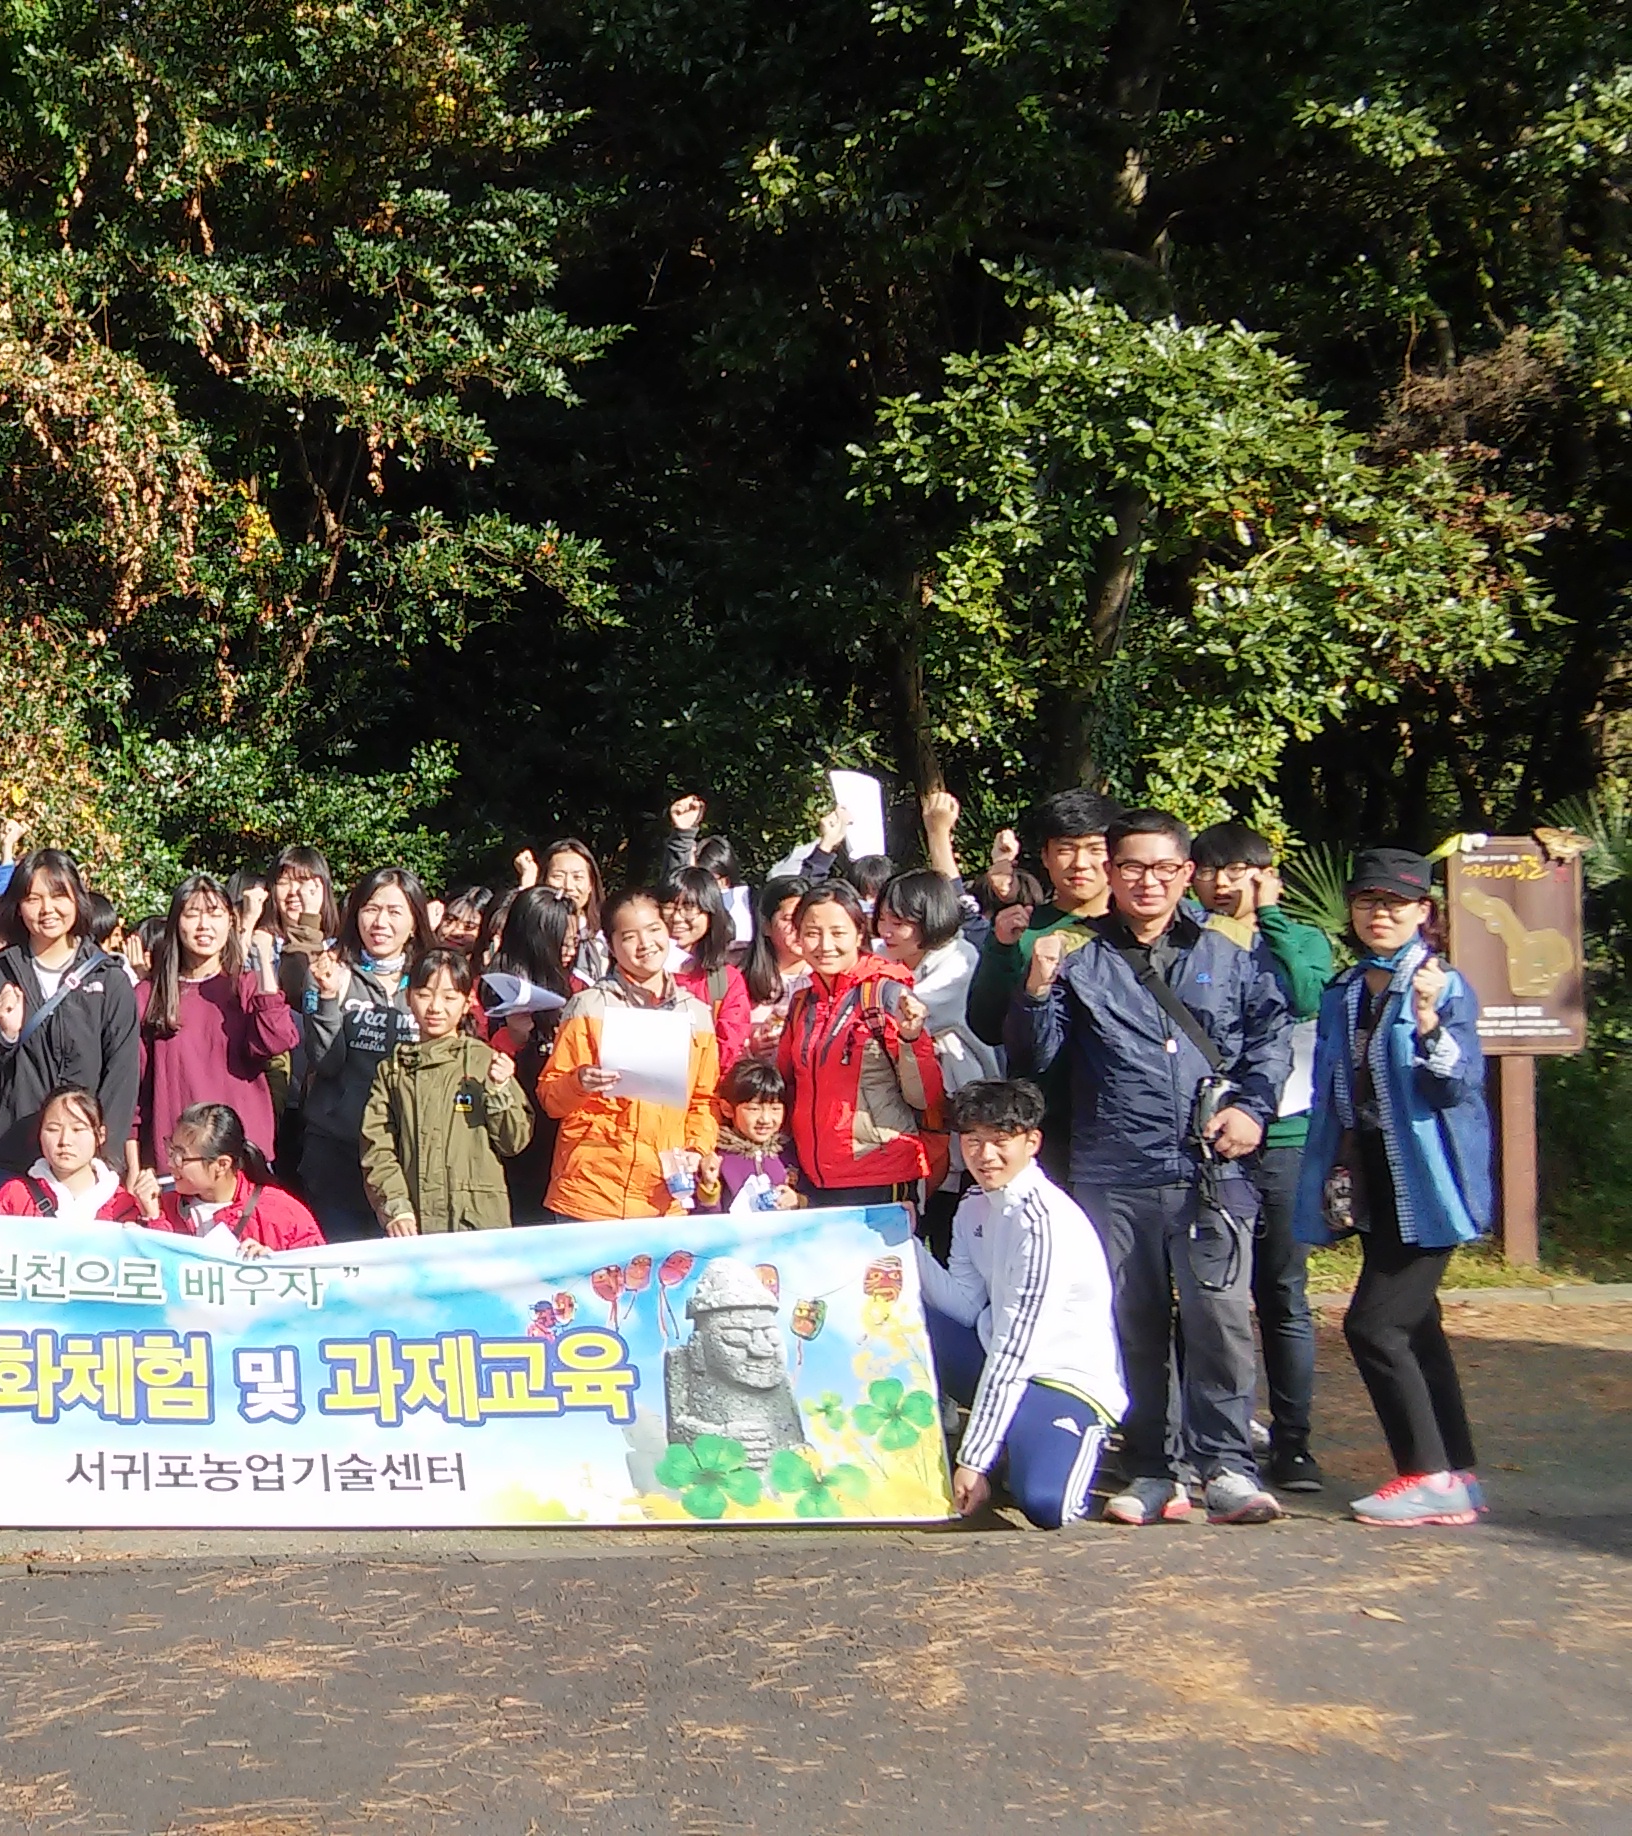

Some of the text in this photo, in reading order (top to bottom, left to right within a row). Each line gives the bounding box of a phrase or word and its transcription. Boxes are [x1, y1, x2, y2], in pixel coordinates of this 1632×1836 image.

[183, 1264, 325, 1307] 배우자
[235, 1347, 303, 1423] 및
[321, 1330, 636, 1425] 과제교육
[65, 1450, 468, 1493] 서귀포농업기술센터
